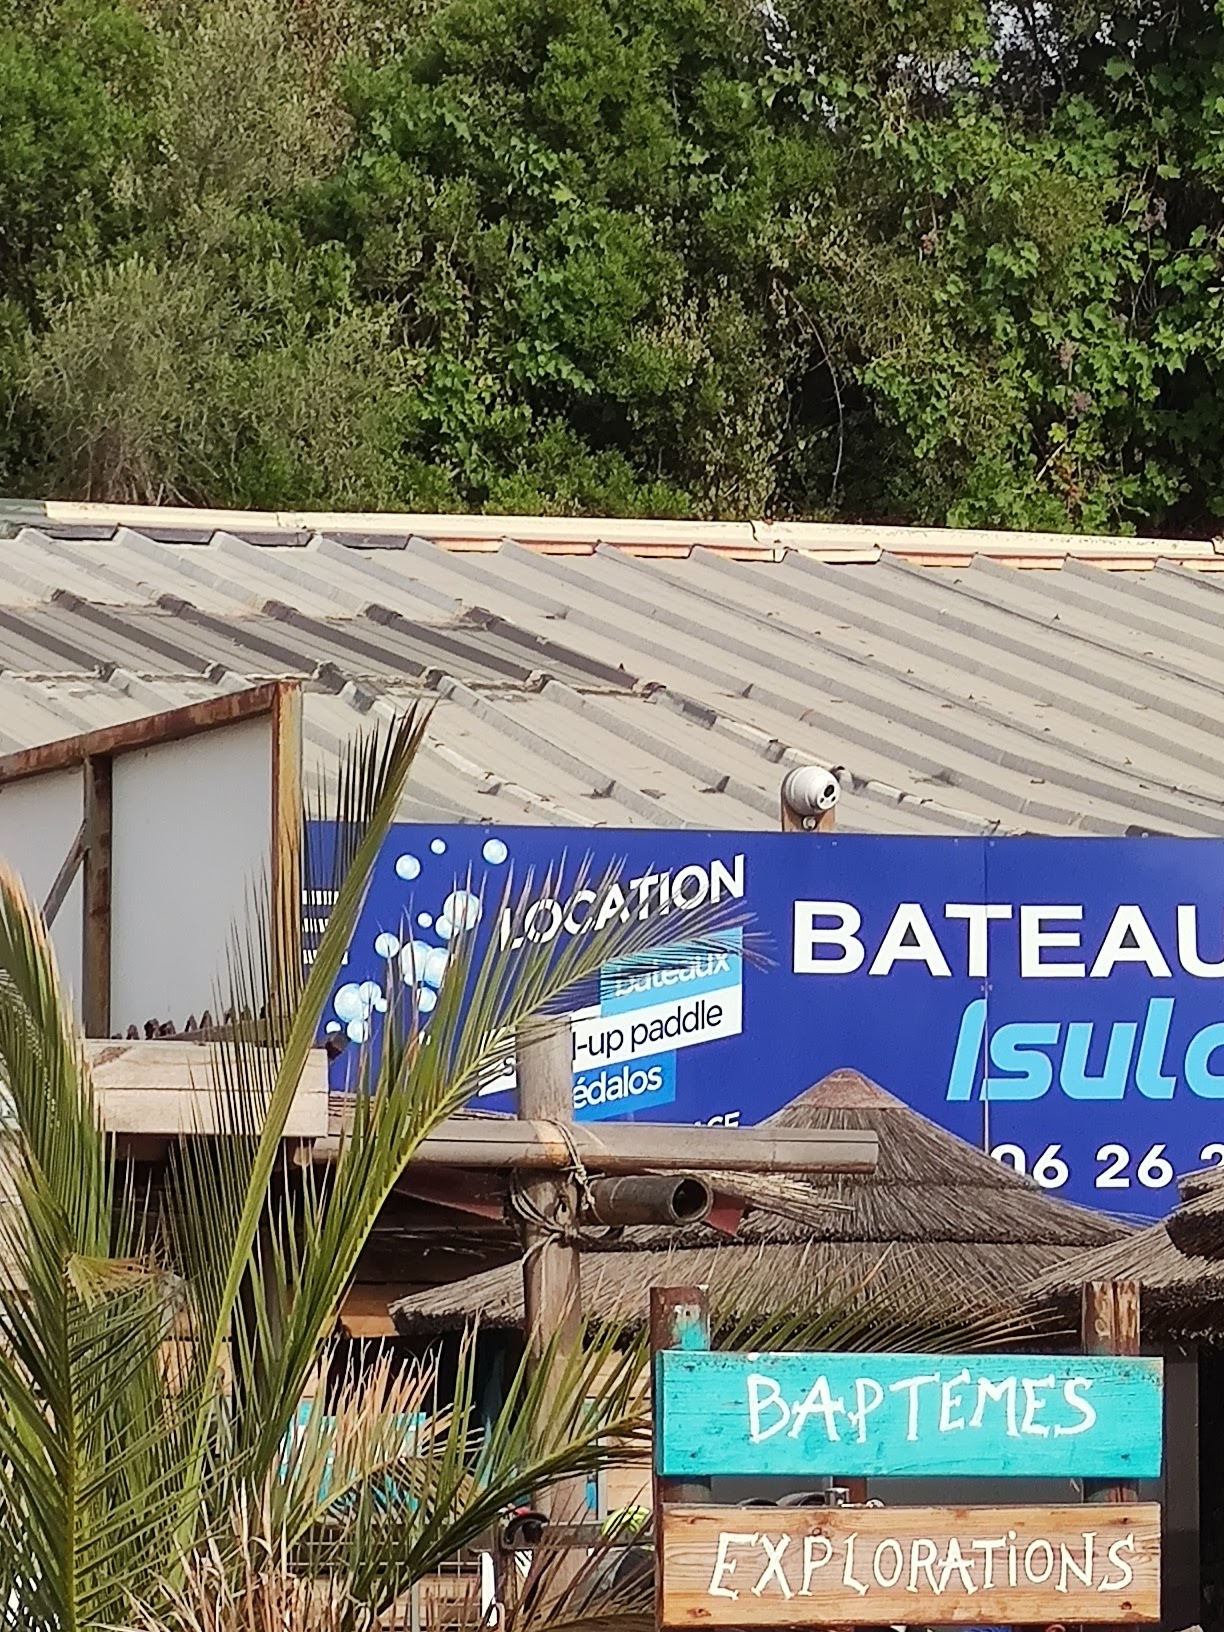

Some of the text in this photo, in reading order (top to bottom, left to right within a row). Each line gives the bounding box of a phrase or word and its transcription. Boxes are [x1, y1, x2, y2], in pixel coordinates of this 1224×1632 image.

[501, 854, 745, 951] LOCATION
[631, 999, 723, 1053] paddle
[573, 1064, 663, 1108] édalos
[1096, 1144, 1174, 1188] 26
